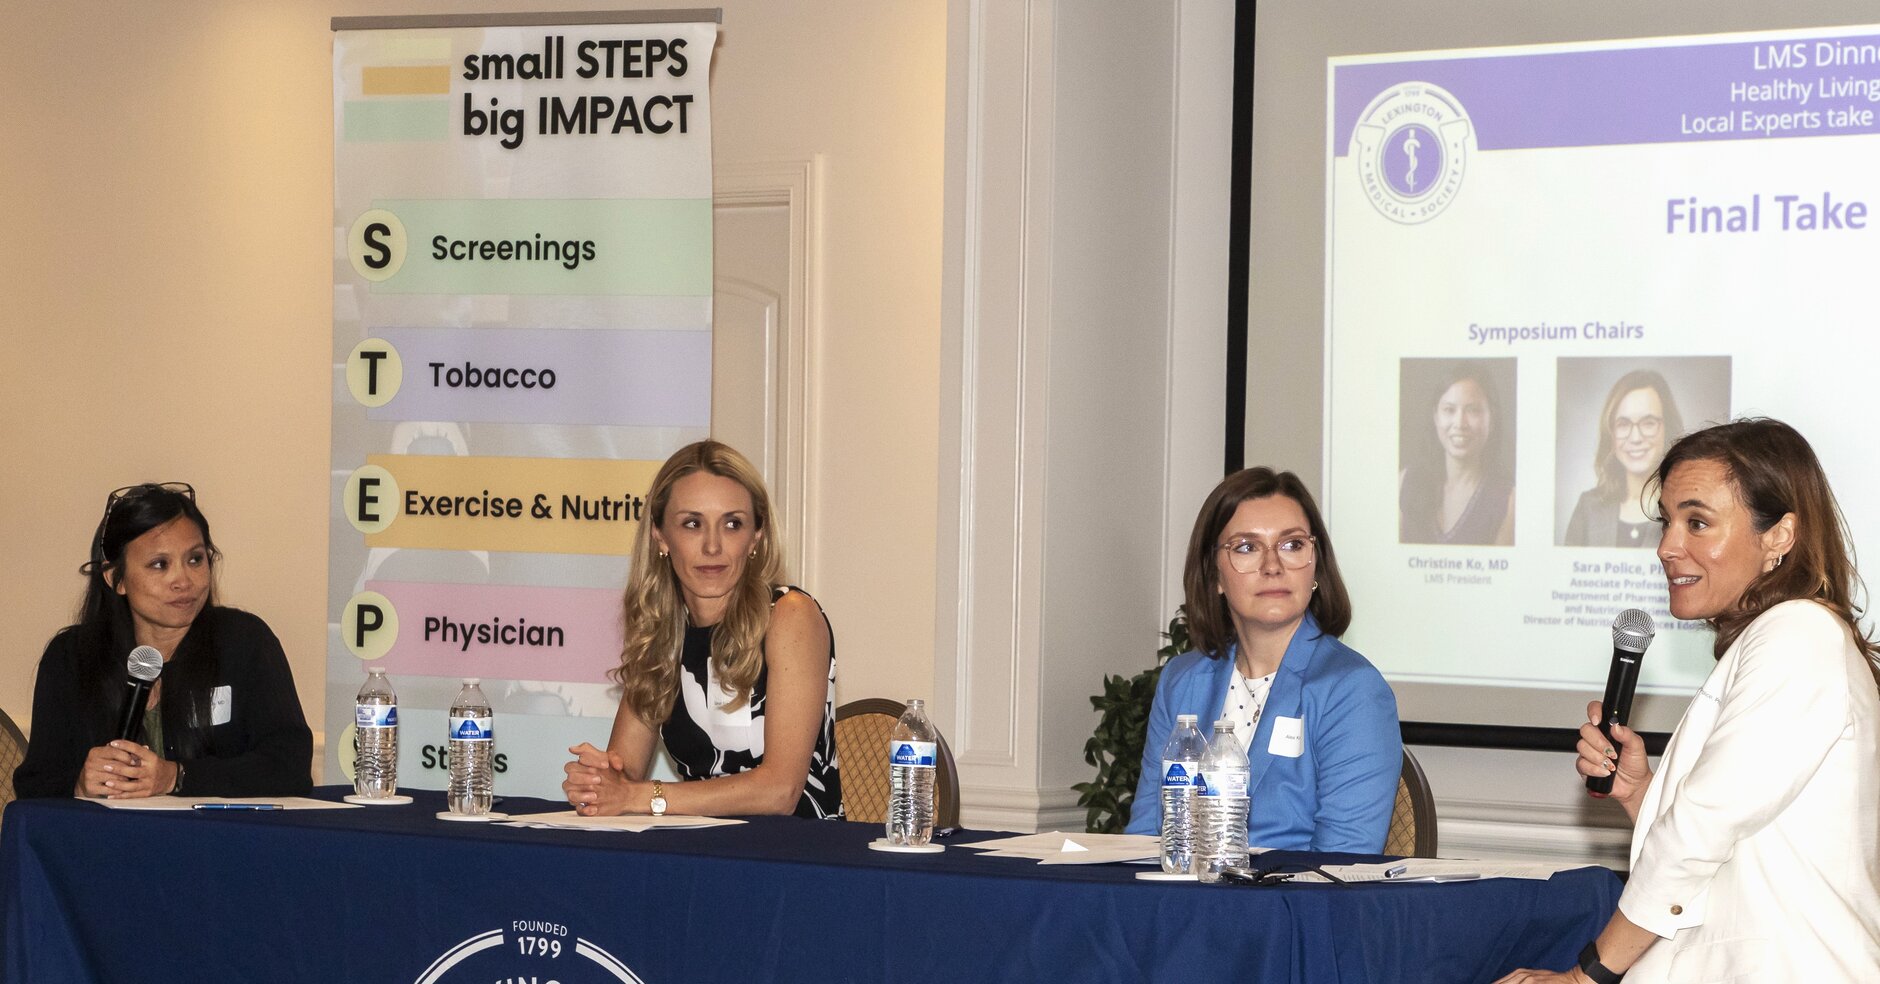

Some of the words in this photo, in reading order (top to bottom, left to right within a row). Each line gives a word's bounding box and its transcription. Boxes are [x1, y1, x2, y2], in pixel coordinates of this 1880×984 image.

[462, 35, 564, 81] small
[575, 38, 688, 79] STEPS
[1754, 43, 1808, 70] LMS
[1815, 41, 1880, 67] Dinn
[1731, 78, 1813, 105] Healthy
[1819, 76, 1880, 102] Living
[463, 92, 525, 150] big
[538, 94, 694, 135] IMPACT
[1382, 103, 1444, 125] LEXINGTON
[1681, 111, 1734, 134] Local
[1741, 109, 1821, 136] Experts
[1827, 105, 1874, 128] take
[1365, 172, 1406, 218] MEDICAL
[1420, 169, 1460, 217] SOCIETY
[1666, 193, 1760, 235] Final
[1773, 191, 1868, 231] Take
[363, 222, 392, 269] S
[431, 233, 597, 270] Screenings
[1468, 322, 1577, 346] Symposium
[1583, 320, 1644, 340] Chairs
[360, 351, 387, 395] T
[428, 361, 556, 390] Tobacco
[358, 477, 381, 522] E
[405, 489, 523, 518] Exercise
[530, 493, 553, 519] &
[561, 493, 646, 521] Nutrit
[1408, 556, 1463, 570] Christine
[1466, 558, 1485, 571] Ko,
[1488, 558, 1509, 570] MD
[1424, 573, 1444, 584] LMS
[1573, 561, 1601, 573] Sara
[1604, 562, 1645, 576] Police,
[1570, 578, 1620, 589] Associate
[356, 604, 384, 648] P
[424, 616, 565, 652] Physician
[421, 744, 508, 774] Sts
[512, 920, 568, 937] FOUNDED
[517, 935, 562, 958] 1799
